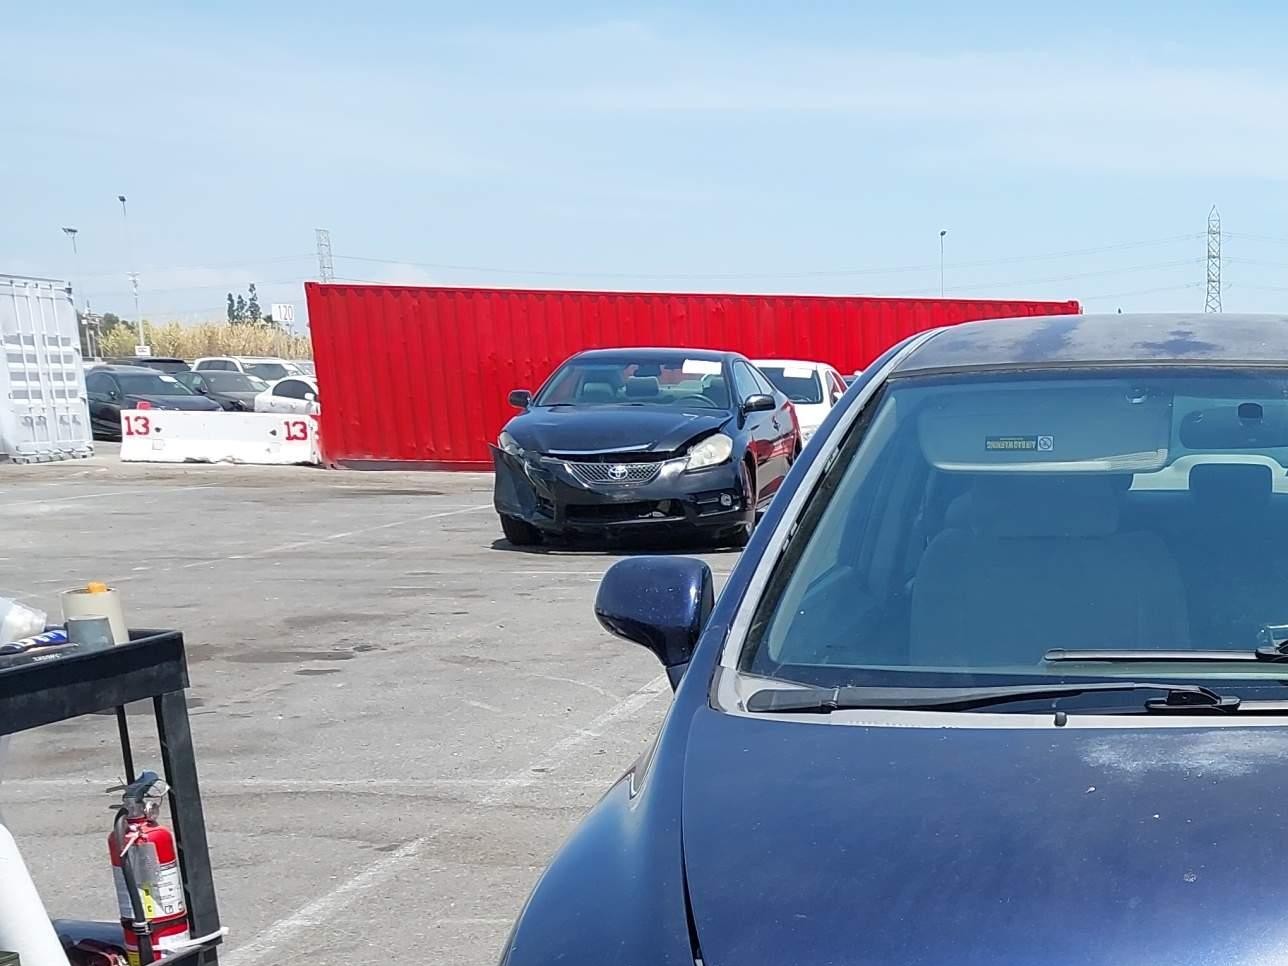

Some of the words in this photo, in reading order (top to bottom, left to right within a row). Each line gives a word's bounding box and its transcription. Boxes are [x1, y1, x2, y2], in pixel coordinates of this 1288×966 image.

[278, 304, 293, 321] 120
[124, 416, 150, 436] 13
[284, 421, 308, 441] 13
